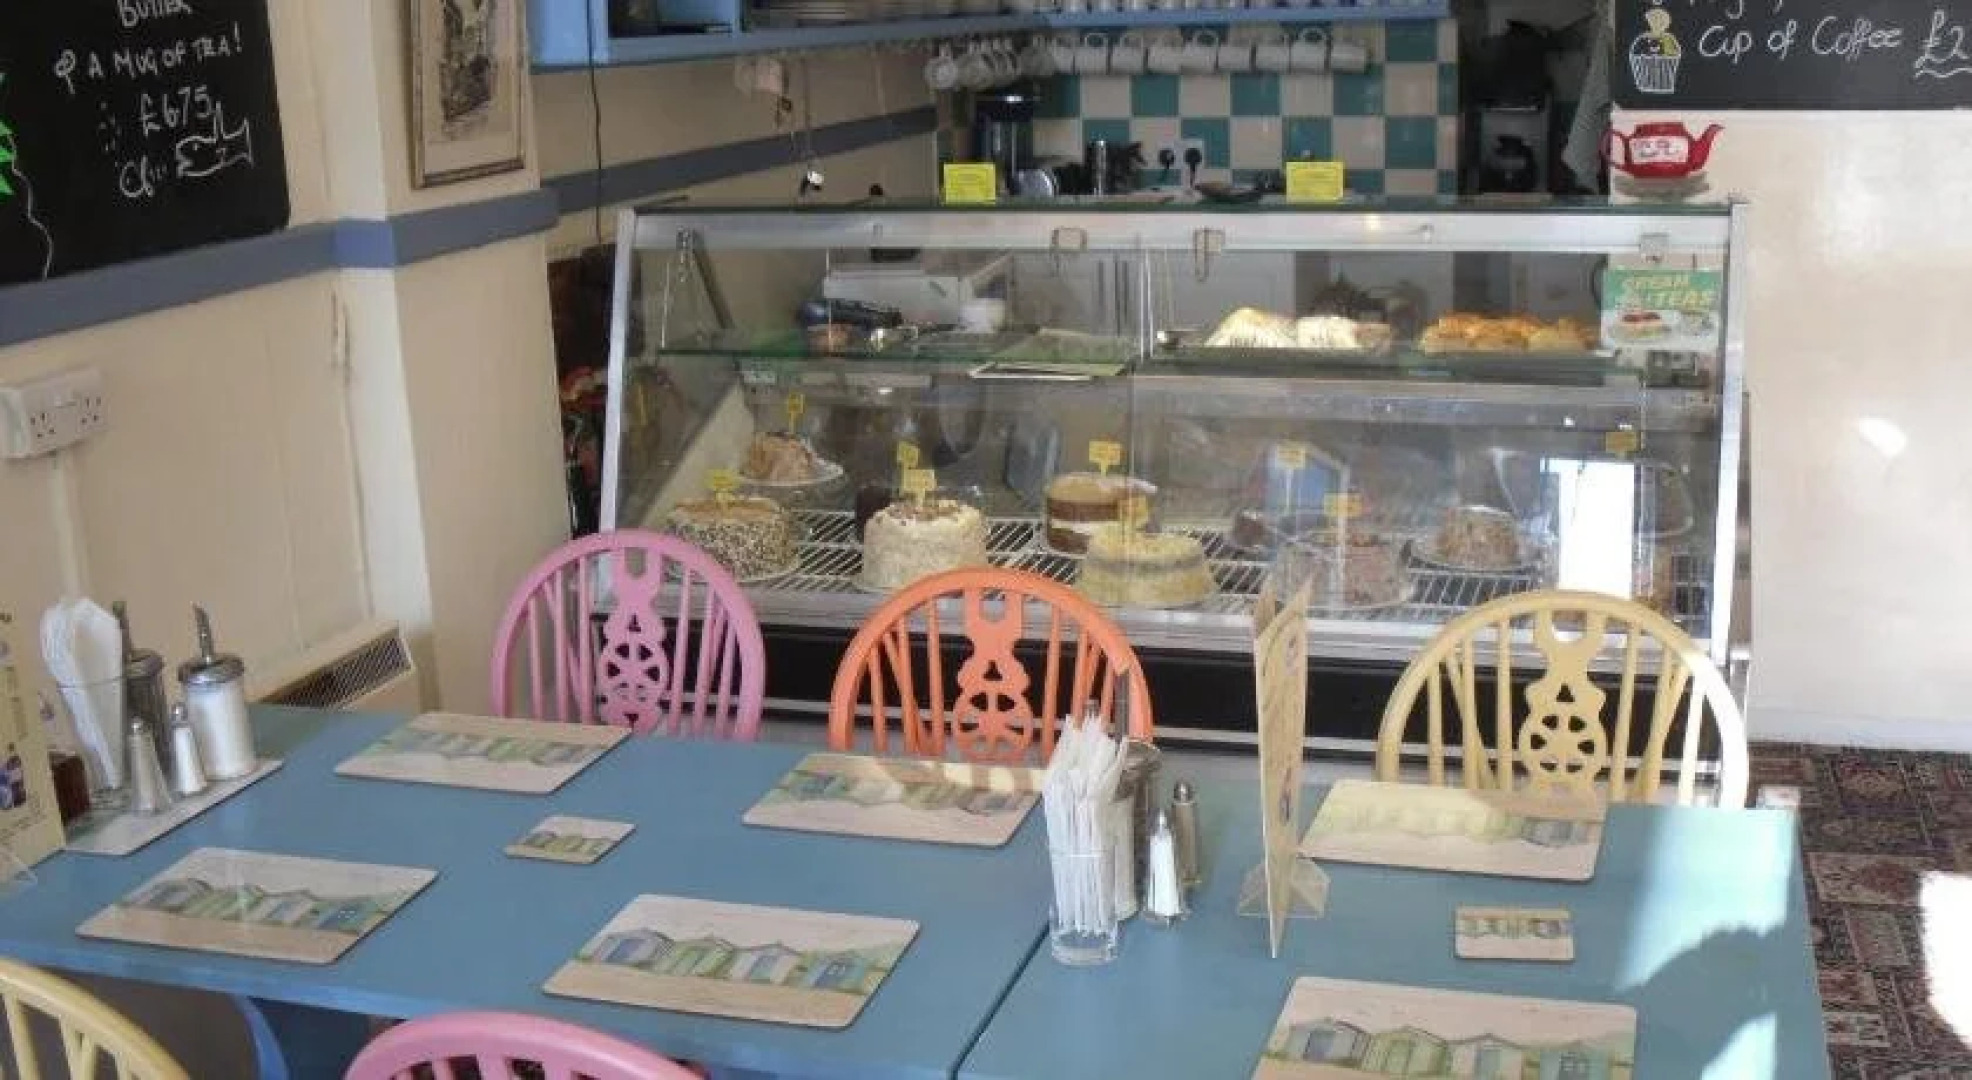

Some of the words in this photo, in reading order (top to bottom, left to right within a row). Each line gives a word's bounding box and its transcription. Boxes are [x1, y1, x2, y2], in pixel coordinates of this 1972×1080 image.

[88, 51, 104, 79] A
[113, 47, 159, 80] MUG
[162, 39, 187, 67] OF
[1698, 25, 1753, 64] Cup
[1767, 18, 1798, 60] of
[1811, 15, 1903, 62] Coffee
